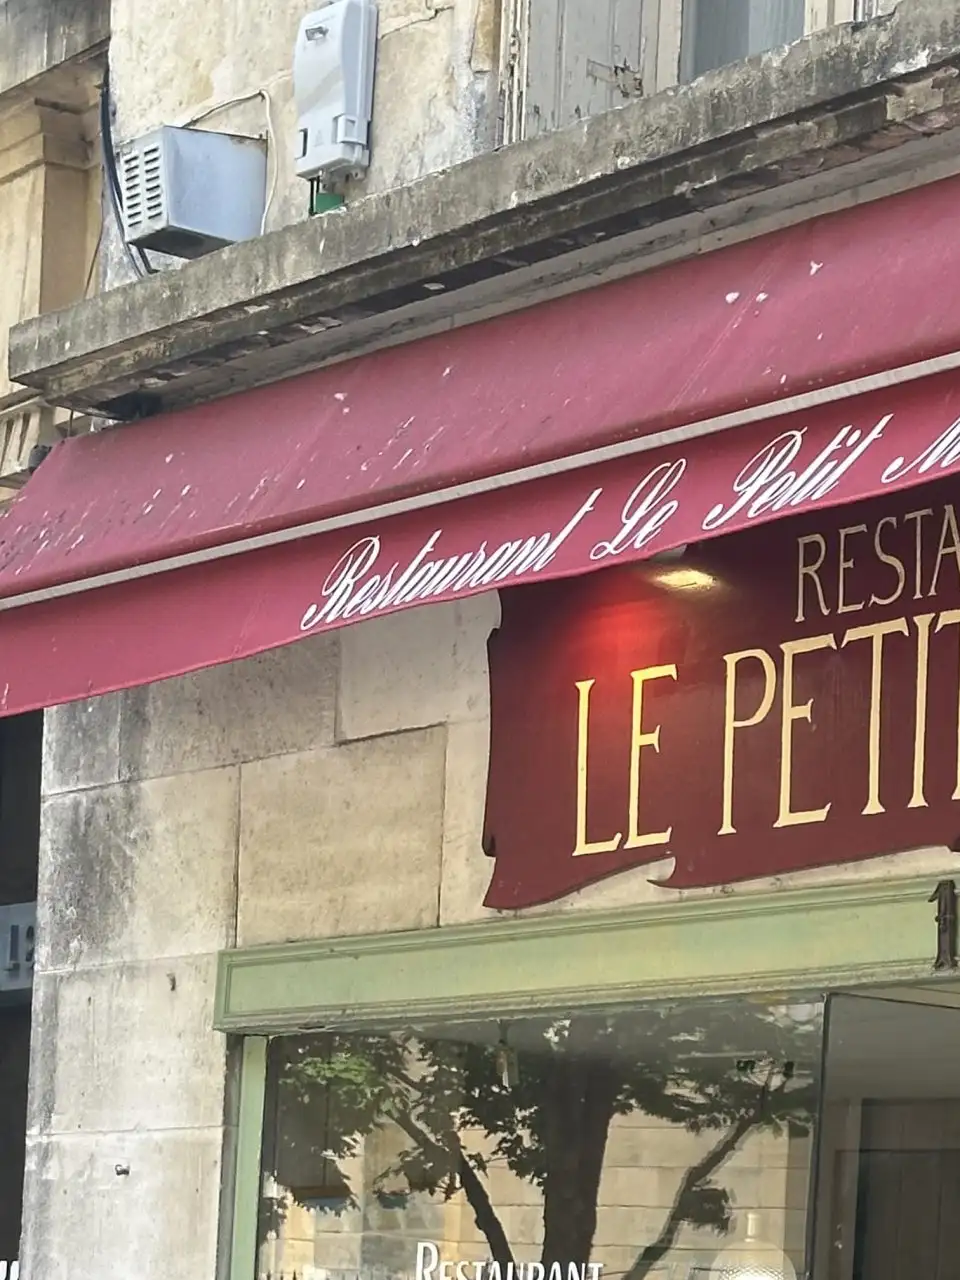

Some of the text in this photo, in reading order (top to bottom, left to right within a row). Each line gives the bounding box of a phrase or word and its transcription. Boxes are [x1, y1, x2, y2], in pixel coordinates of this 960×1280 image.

[300, 487, 603, 631] Restaurant
[590, 458, 688, 560] Le
[702, 413, 894, 531] Petit
[572, 663, 678, 858] LE
